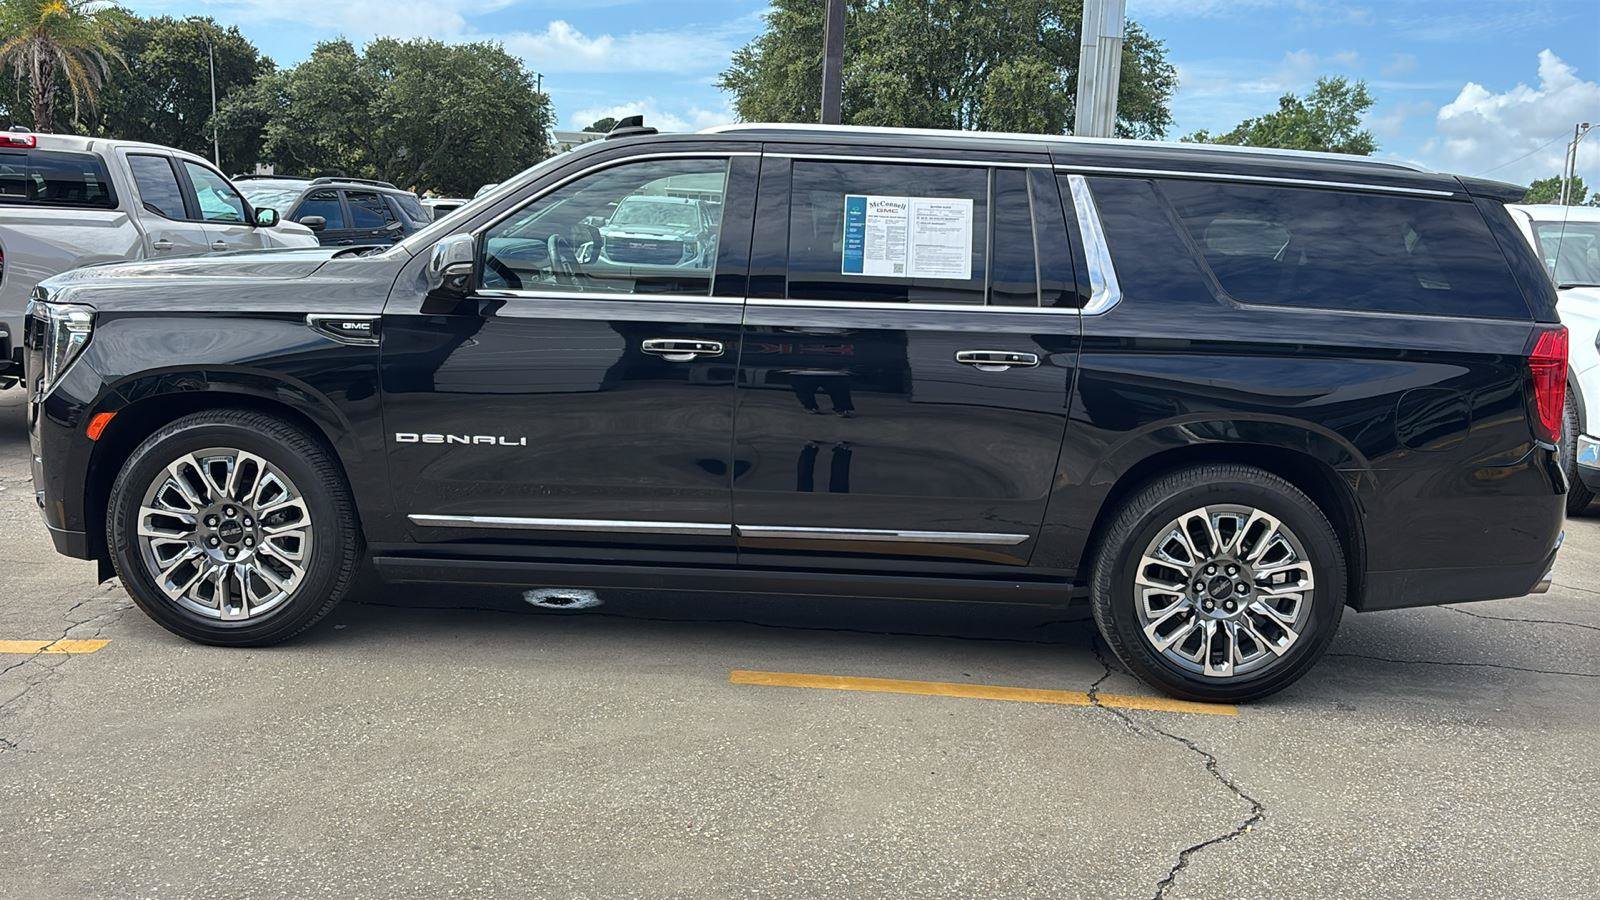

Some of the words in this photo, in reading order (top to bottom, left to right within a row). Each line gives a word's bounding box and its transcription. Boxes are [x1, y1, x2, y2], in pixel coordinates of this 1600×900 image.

[869, 201, 907, 210] McConnell
[342, 322, 370, 330] GMC
[395, 432, 527, 446] DENALI
